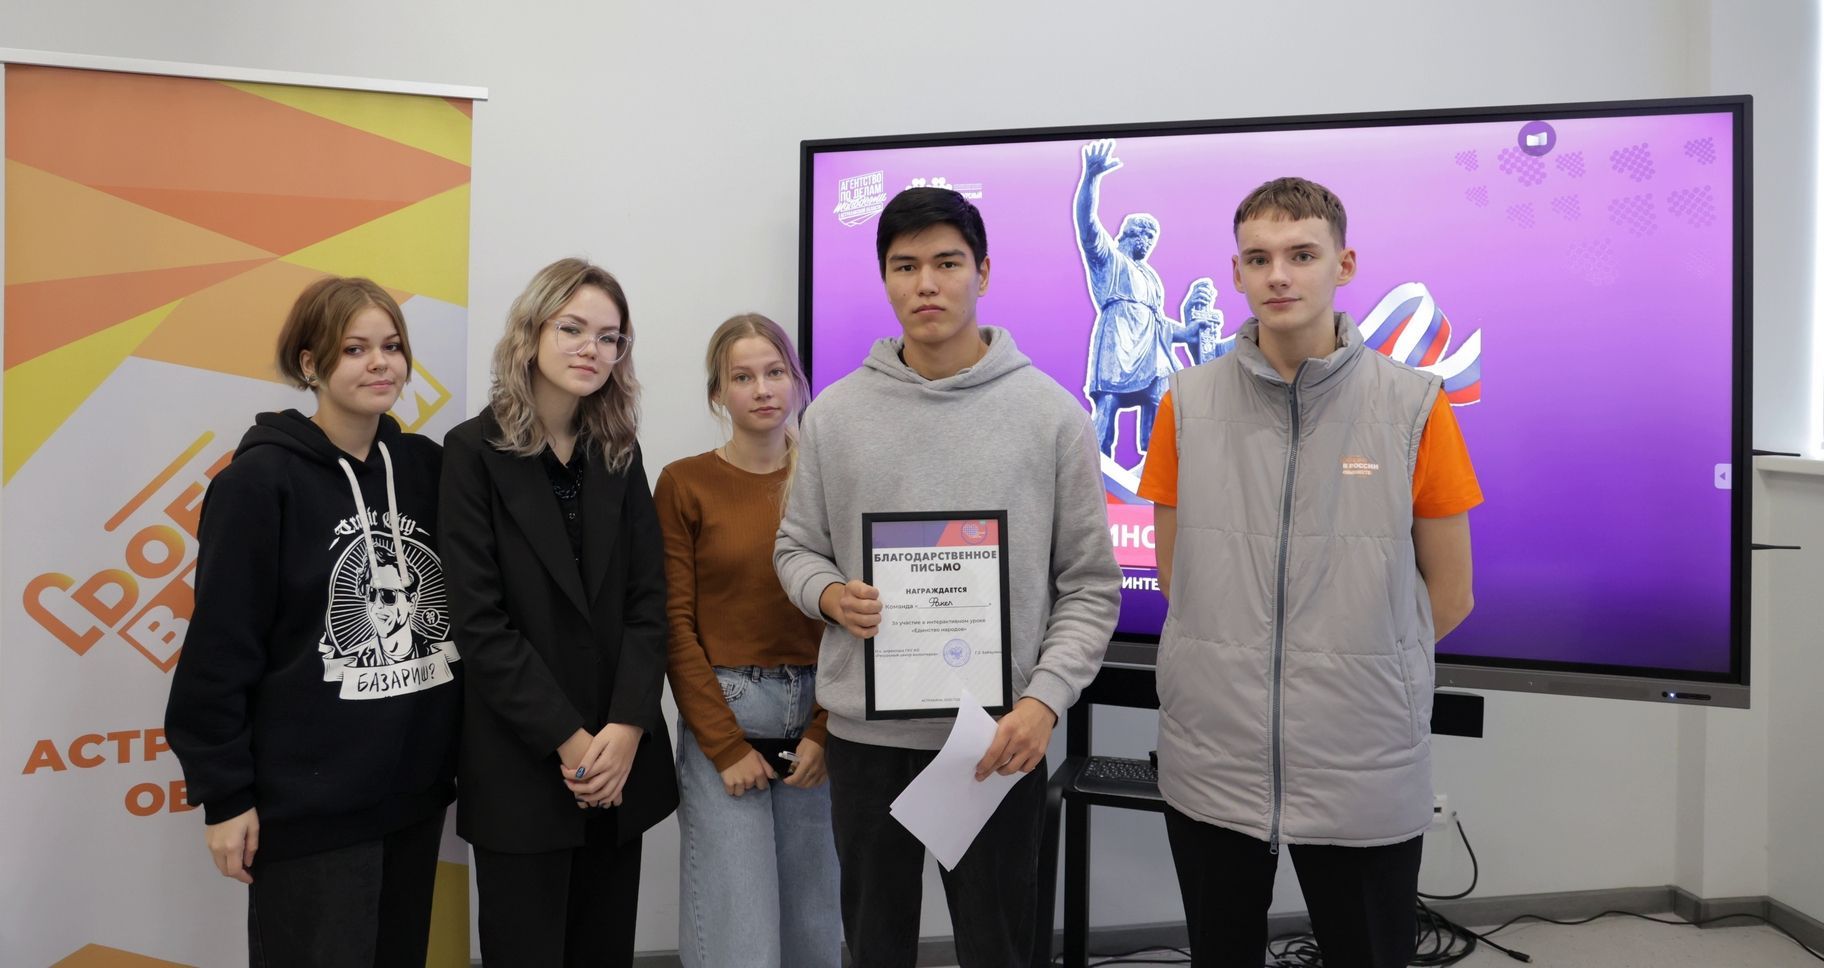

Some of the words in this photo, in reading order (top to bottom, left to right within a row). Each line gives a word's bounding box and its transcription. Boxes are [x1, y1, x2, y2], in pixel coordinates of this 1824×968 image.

[840, 172, 882, 191] АГЕНТСТВО
[382, 511, 416, 536] Cty
[874, 550, 997, 563] БЛАГОДАРСТВЕННОЕ
[910, 562, 961, 573] ПИСЬМО
[905, 587, 967, 595] НАГРАЖДАЕТСЯ
